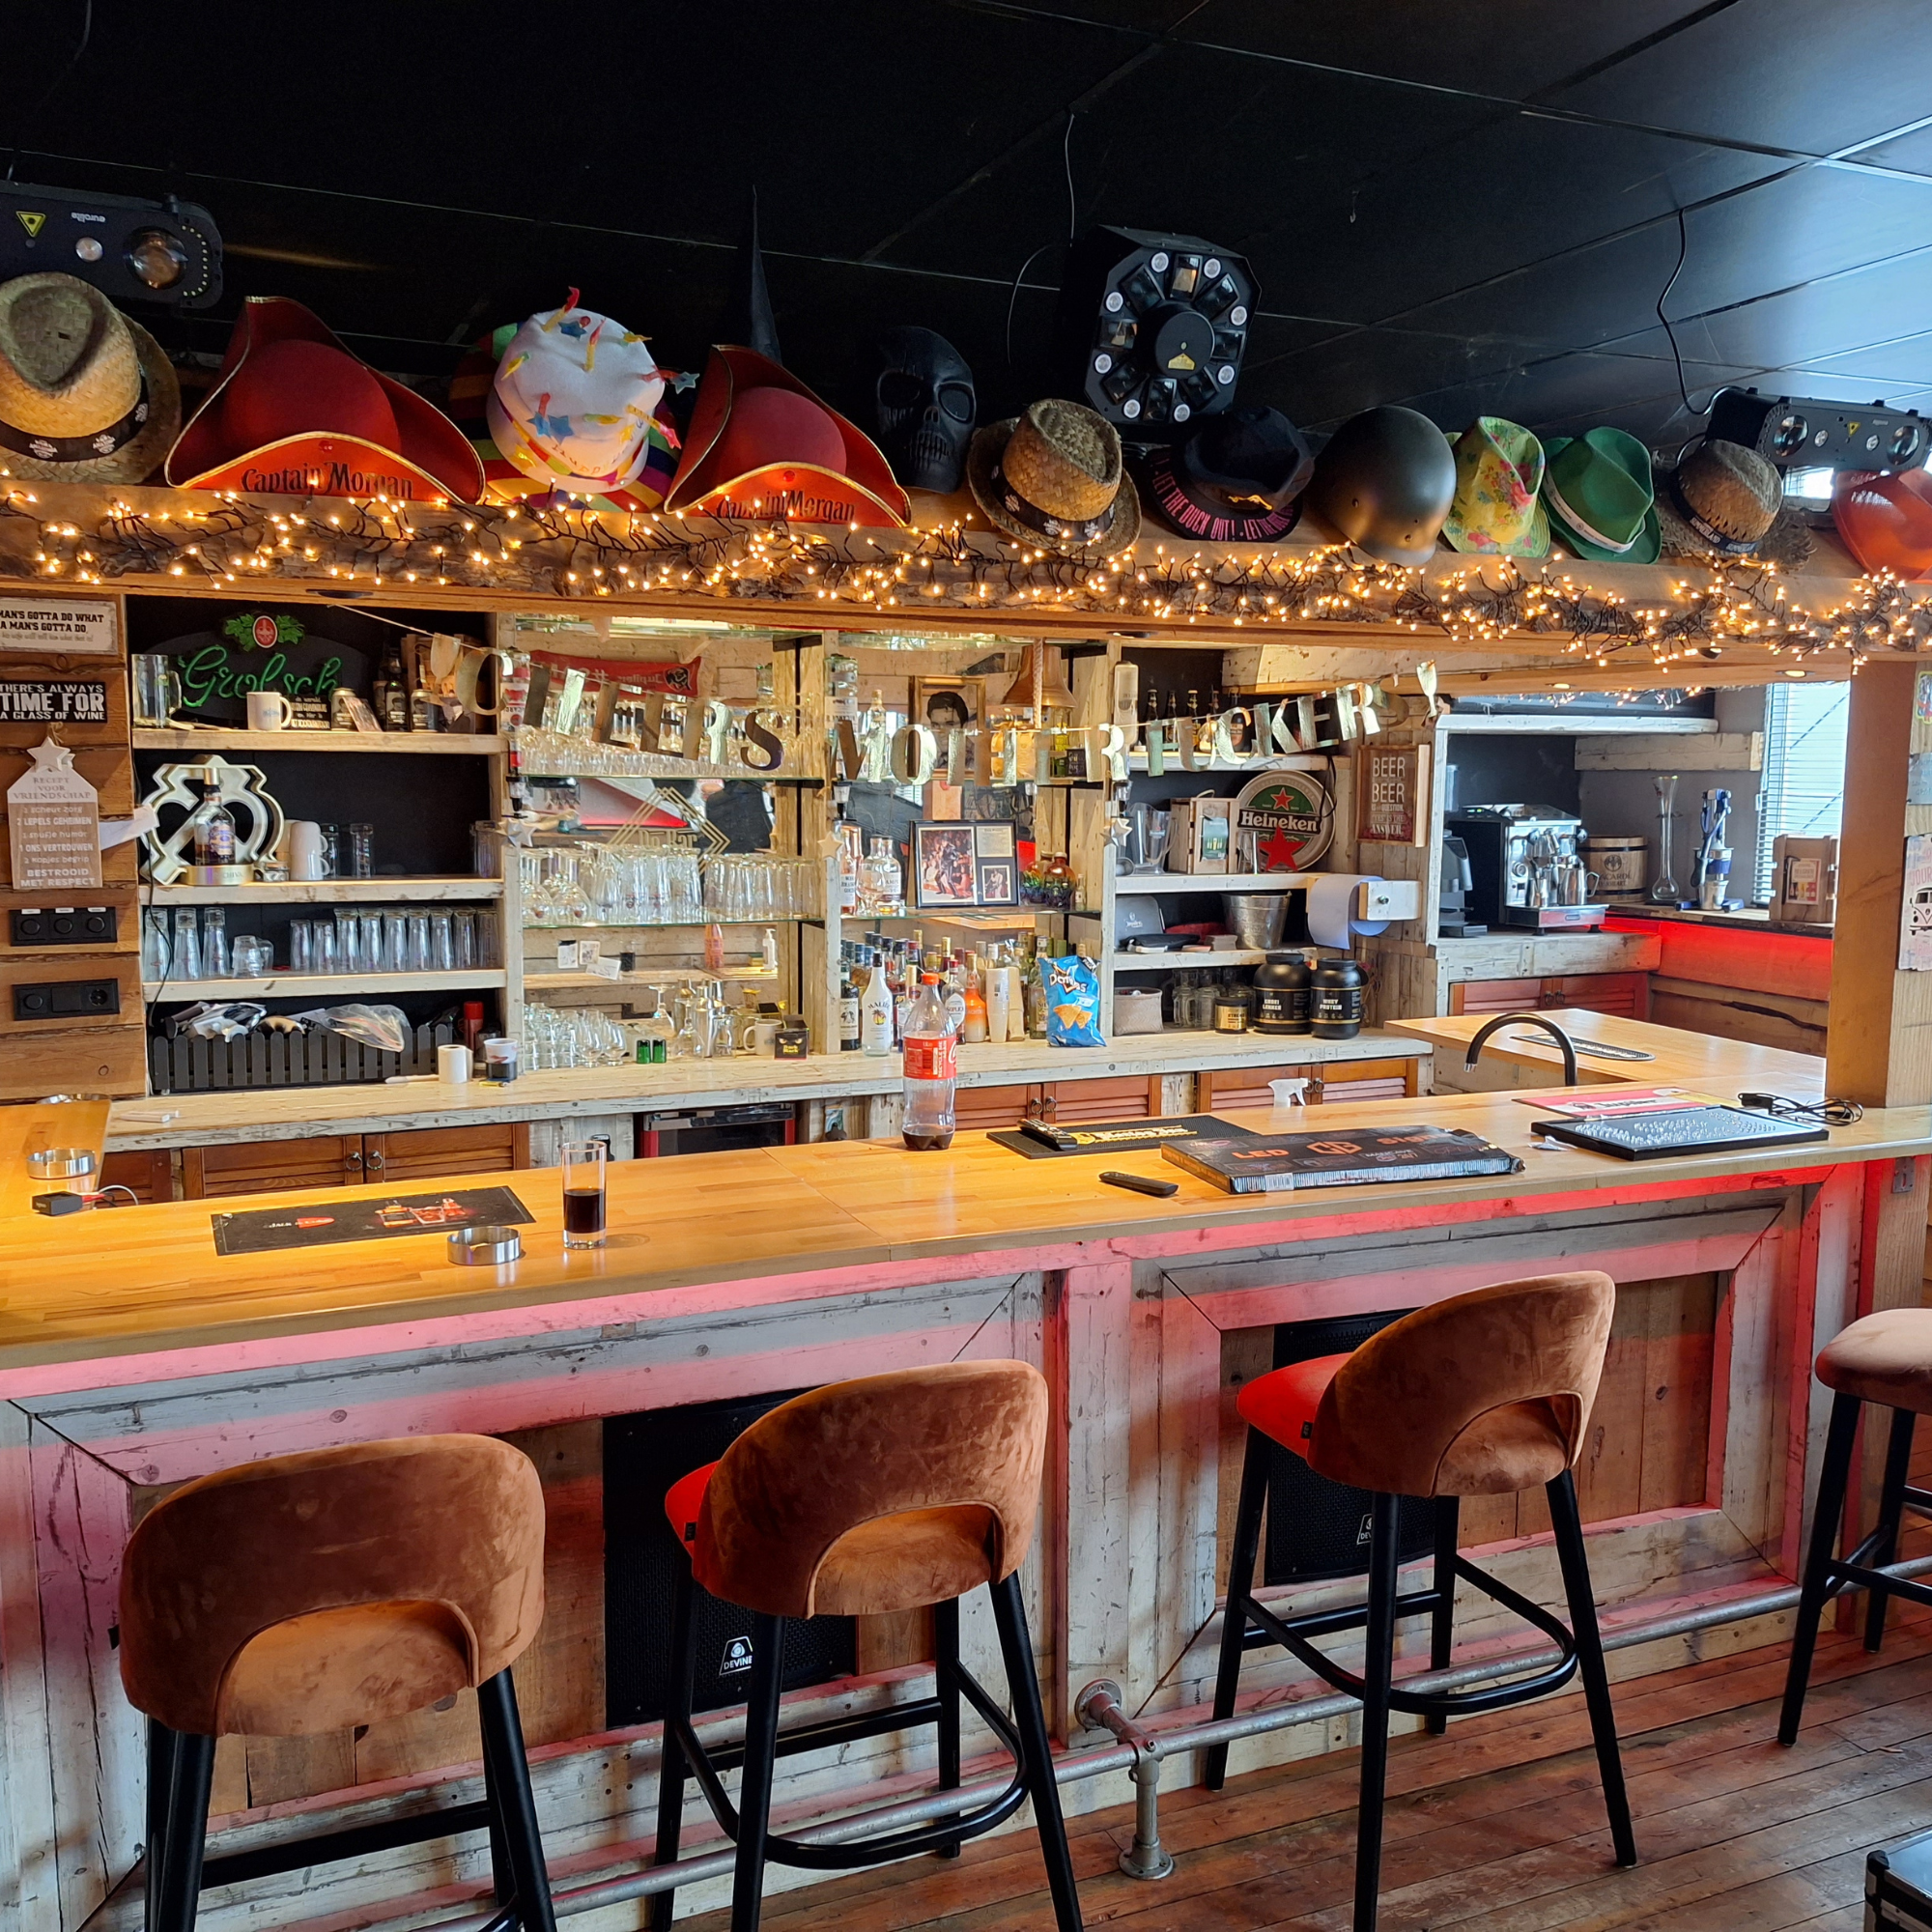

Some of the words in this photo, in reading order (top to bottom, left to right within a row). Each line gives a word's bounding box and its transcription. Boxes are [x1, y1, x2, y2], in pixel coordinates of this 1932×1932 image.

[242, 462, 322, 494] Captain
[323, 461, 413, 499] Morgan
[1151, 470, 1177, 495] LET
[716, 490, 783, 519] Capain
[785, 490, 855, 523] Morgan
[1161, 487, 1190, 518] THE
[1178, 503, 1212, 536] DUCK
[1209, 516, 1236, 542] OUT!
[1242, 518, 1263, 540] LET
[0, 620, 7, 630] A
[9, 620, 40, 631] MAN'S
[41, 622, 72, 633] GOTTA
[27, 611, 59, 621] GOTTA
[60, 612, 73, 621] DO
[74, 612, 104, 623] WHAT
[183, 644, 344, 707] Grolsch
[0, 683, 44, 693] THERE'S
[49, 684, 103, 694] ALWAYS
[1, 693, 54, 712] TIME
[61, 693, 104, 712] FOR
[0, 711, 9, 720] A
[13, 711, 51, 720] GLASS
[1372, 756, 1406, 778] BEER
[1372, 782, 1405, 803] BEER
[63, 806, 83, 814] zorg
[24, 817, 51, 826] LEPELS
[53, 816, 92, 825] GEHEIMEN
[1240, 810, 1318, 832] Heineken
[29, 831, 58, 839] snufje
[666, 830, 698, 849] Bar
[25, 843, 41, 852] ONS
[43, 843, 94, 852] VERTROUWEN
[27, 868, 90, 877] BESTROOID
[47, 877, 96, 887] RESPECT
[1048, 973, 1089, 993] Doritos
[1231, 1148, 1291, 1160] LED
[724, 1655, 753, 1670] DEVINE
